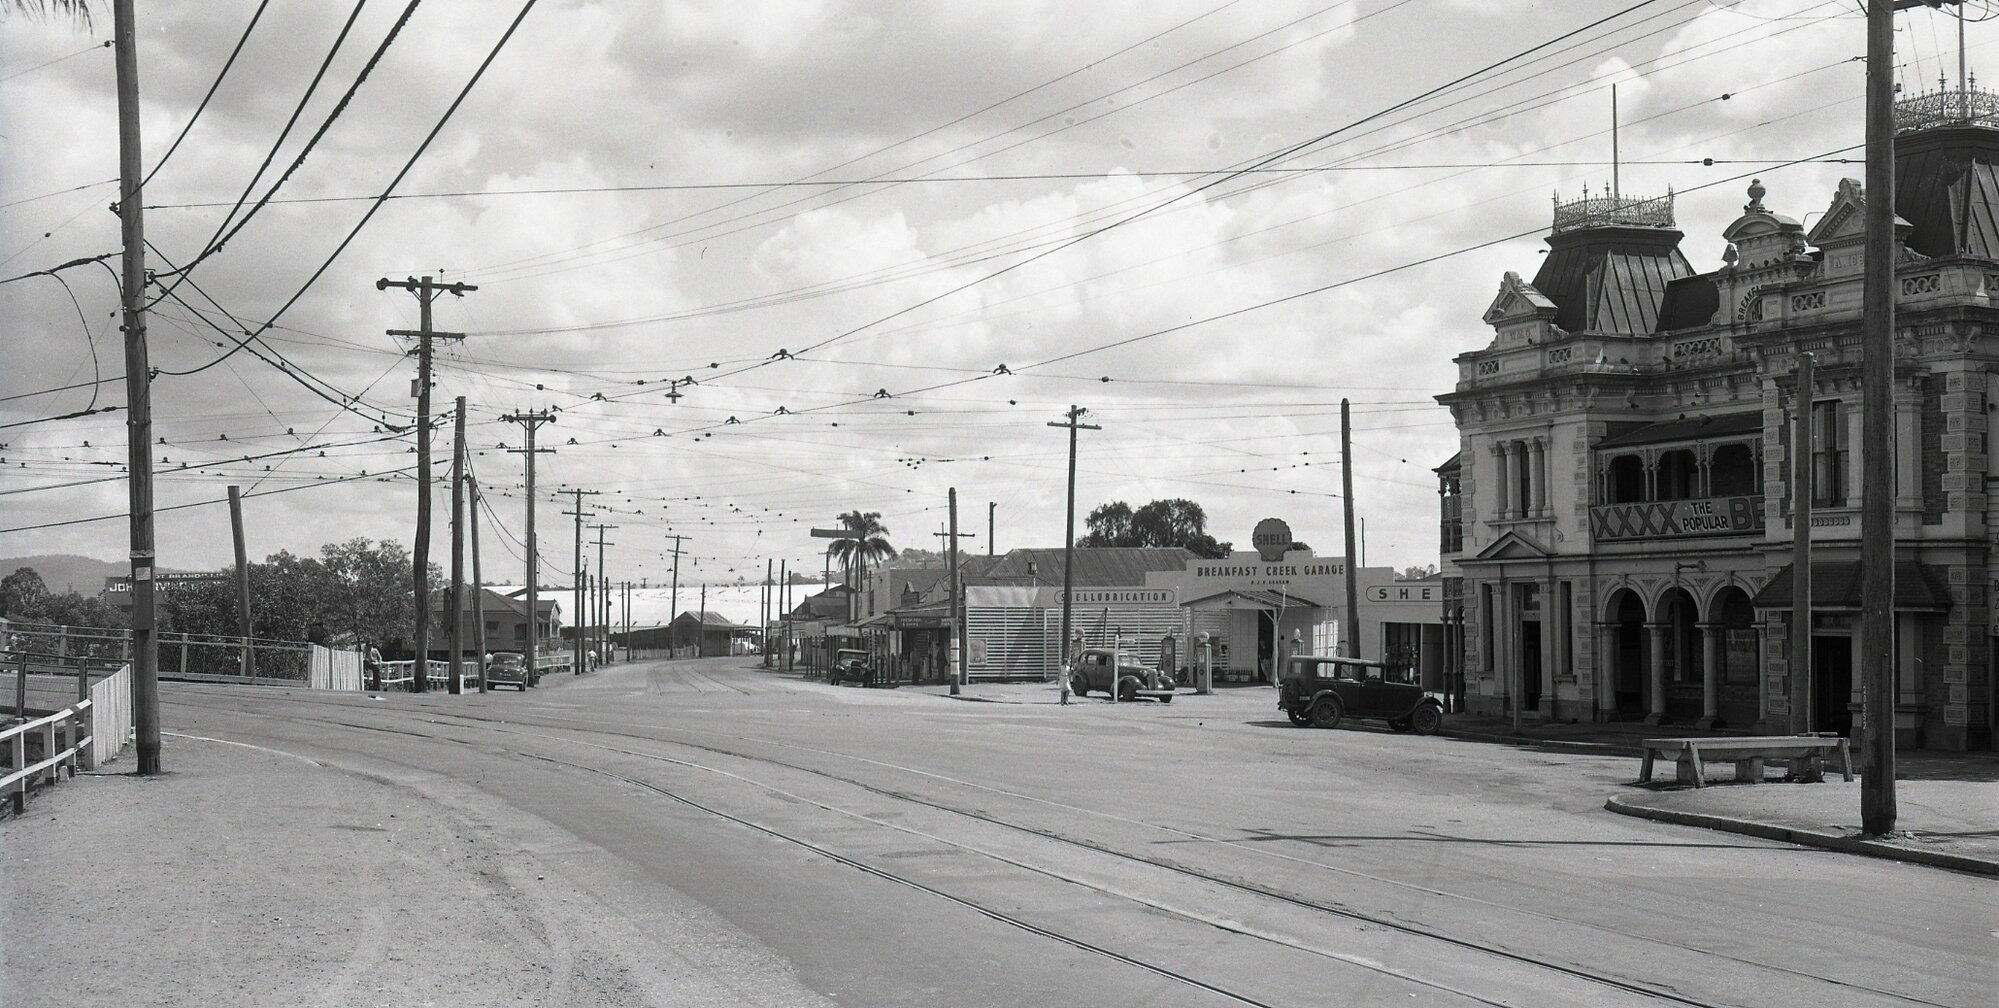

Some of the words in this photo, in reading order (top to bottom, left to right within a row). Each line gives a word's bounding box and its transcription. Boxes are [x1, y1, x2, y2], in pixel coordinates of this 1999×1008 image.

[1691, 501, 1713, 515] THE
[1728, 496, 1766, 530] BE
[1592, 502, 1682, 537] XXXX
[1682, 515, 1729, 531] POPULAR
[1256, 534, 1288, 545] SHELL
[1197, 566, 1257, 577] BREAKFAST
[1266, 566, 1297, 576] CREEK
[1304, 564, 1344, 575] GARAGE
[1061, 592, 1167, 602] SELLUBRICATION
[1379, 588, 1431, 600] SHE
